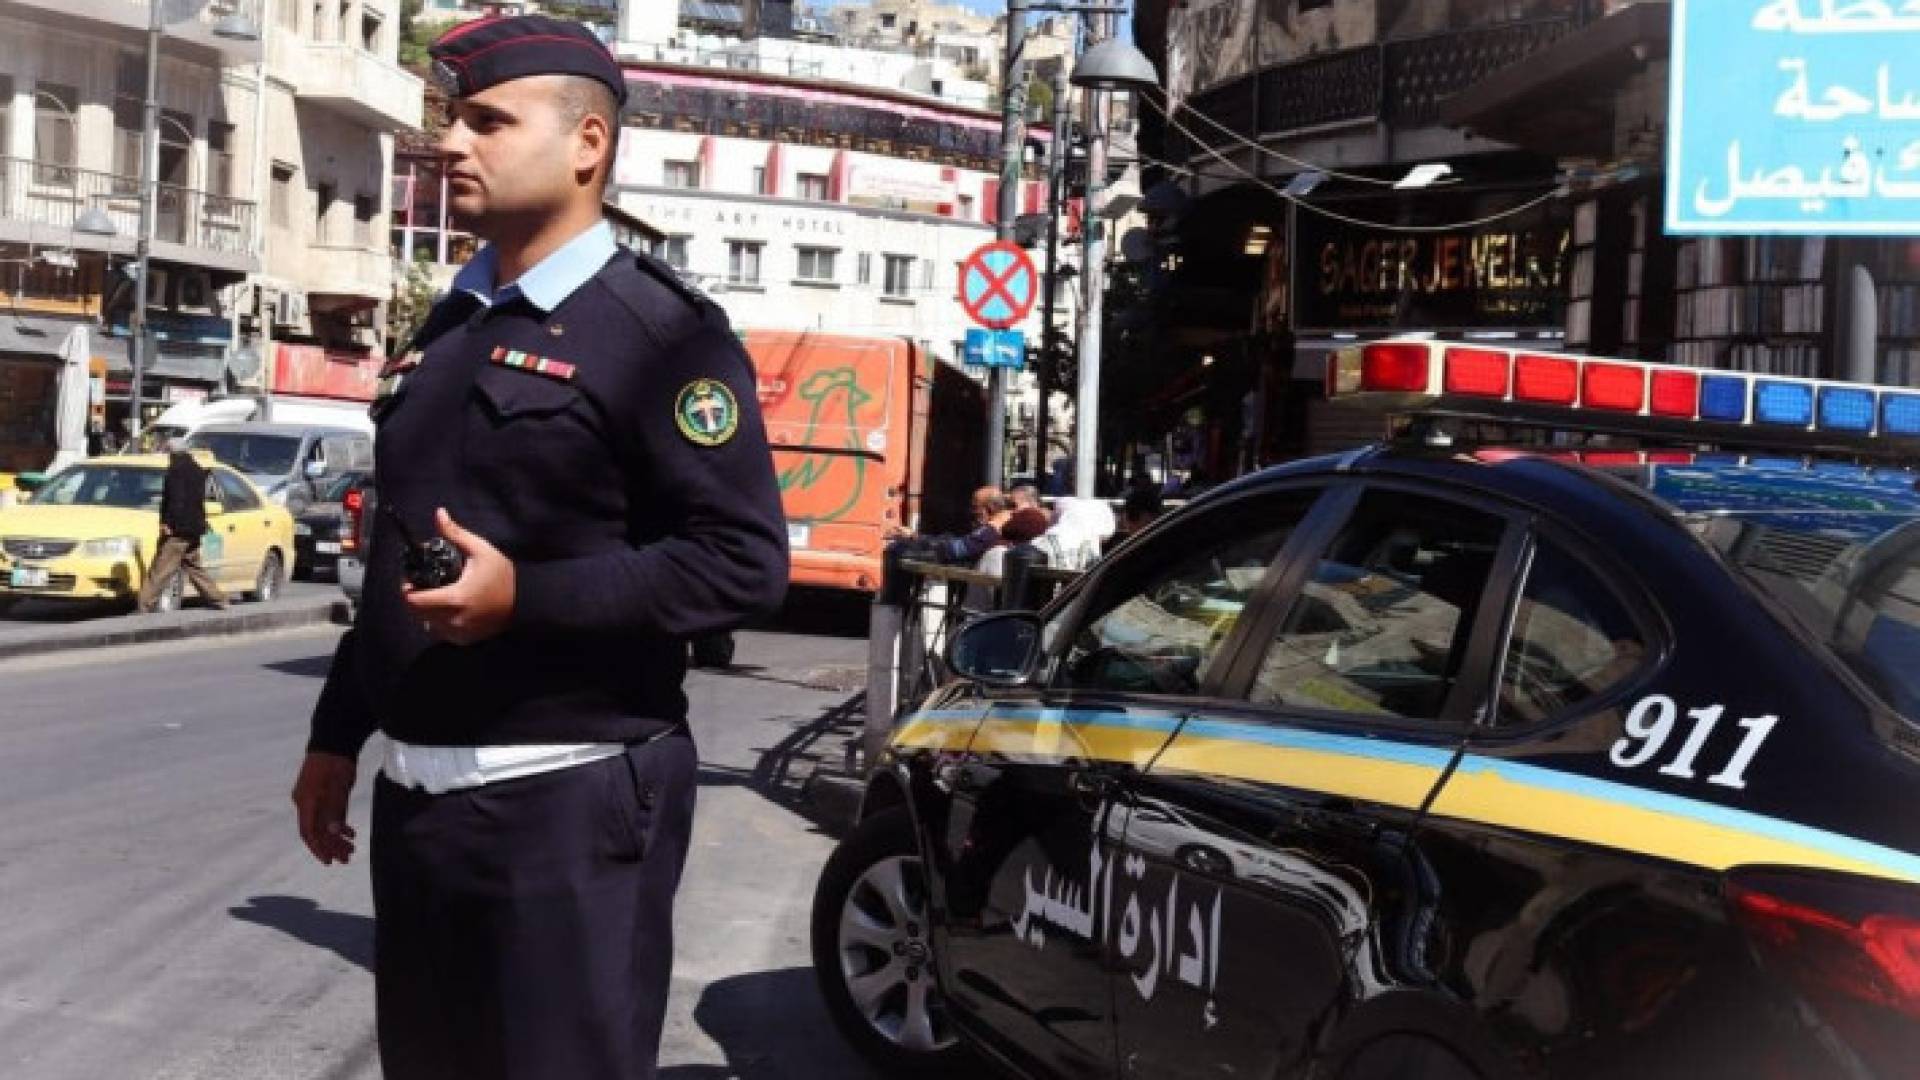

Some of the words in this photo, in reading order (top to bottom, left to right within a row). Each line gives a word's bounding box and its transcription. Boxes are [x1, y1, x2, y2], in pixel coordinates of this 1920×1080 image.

[1694, 135, 1871, 216] فيصل
[1609, 693, 1779, 789] 911
[1010, 826, 1114, 951] السير
[1119, 852, 1222, 1030] إدارة
